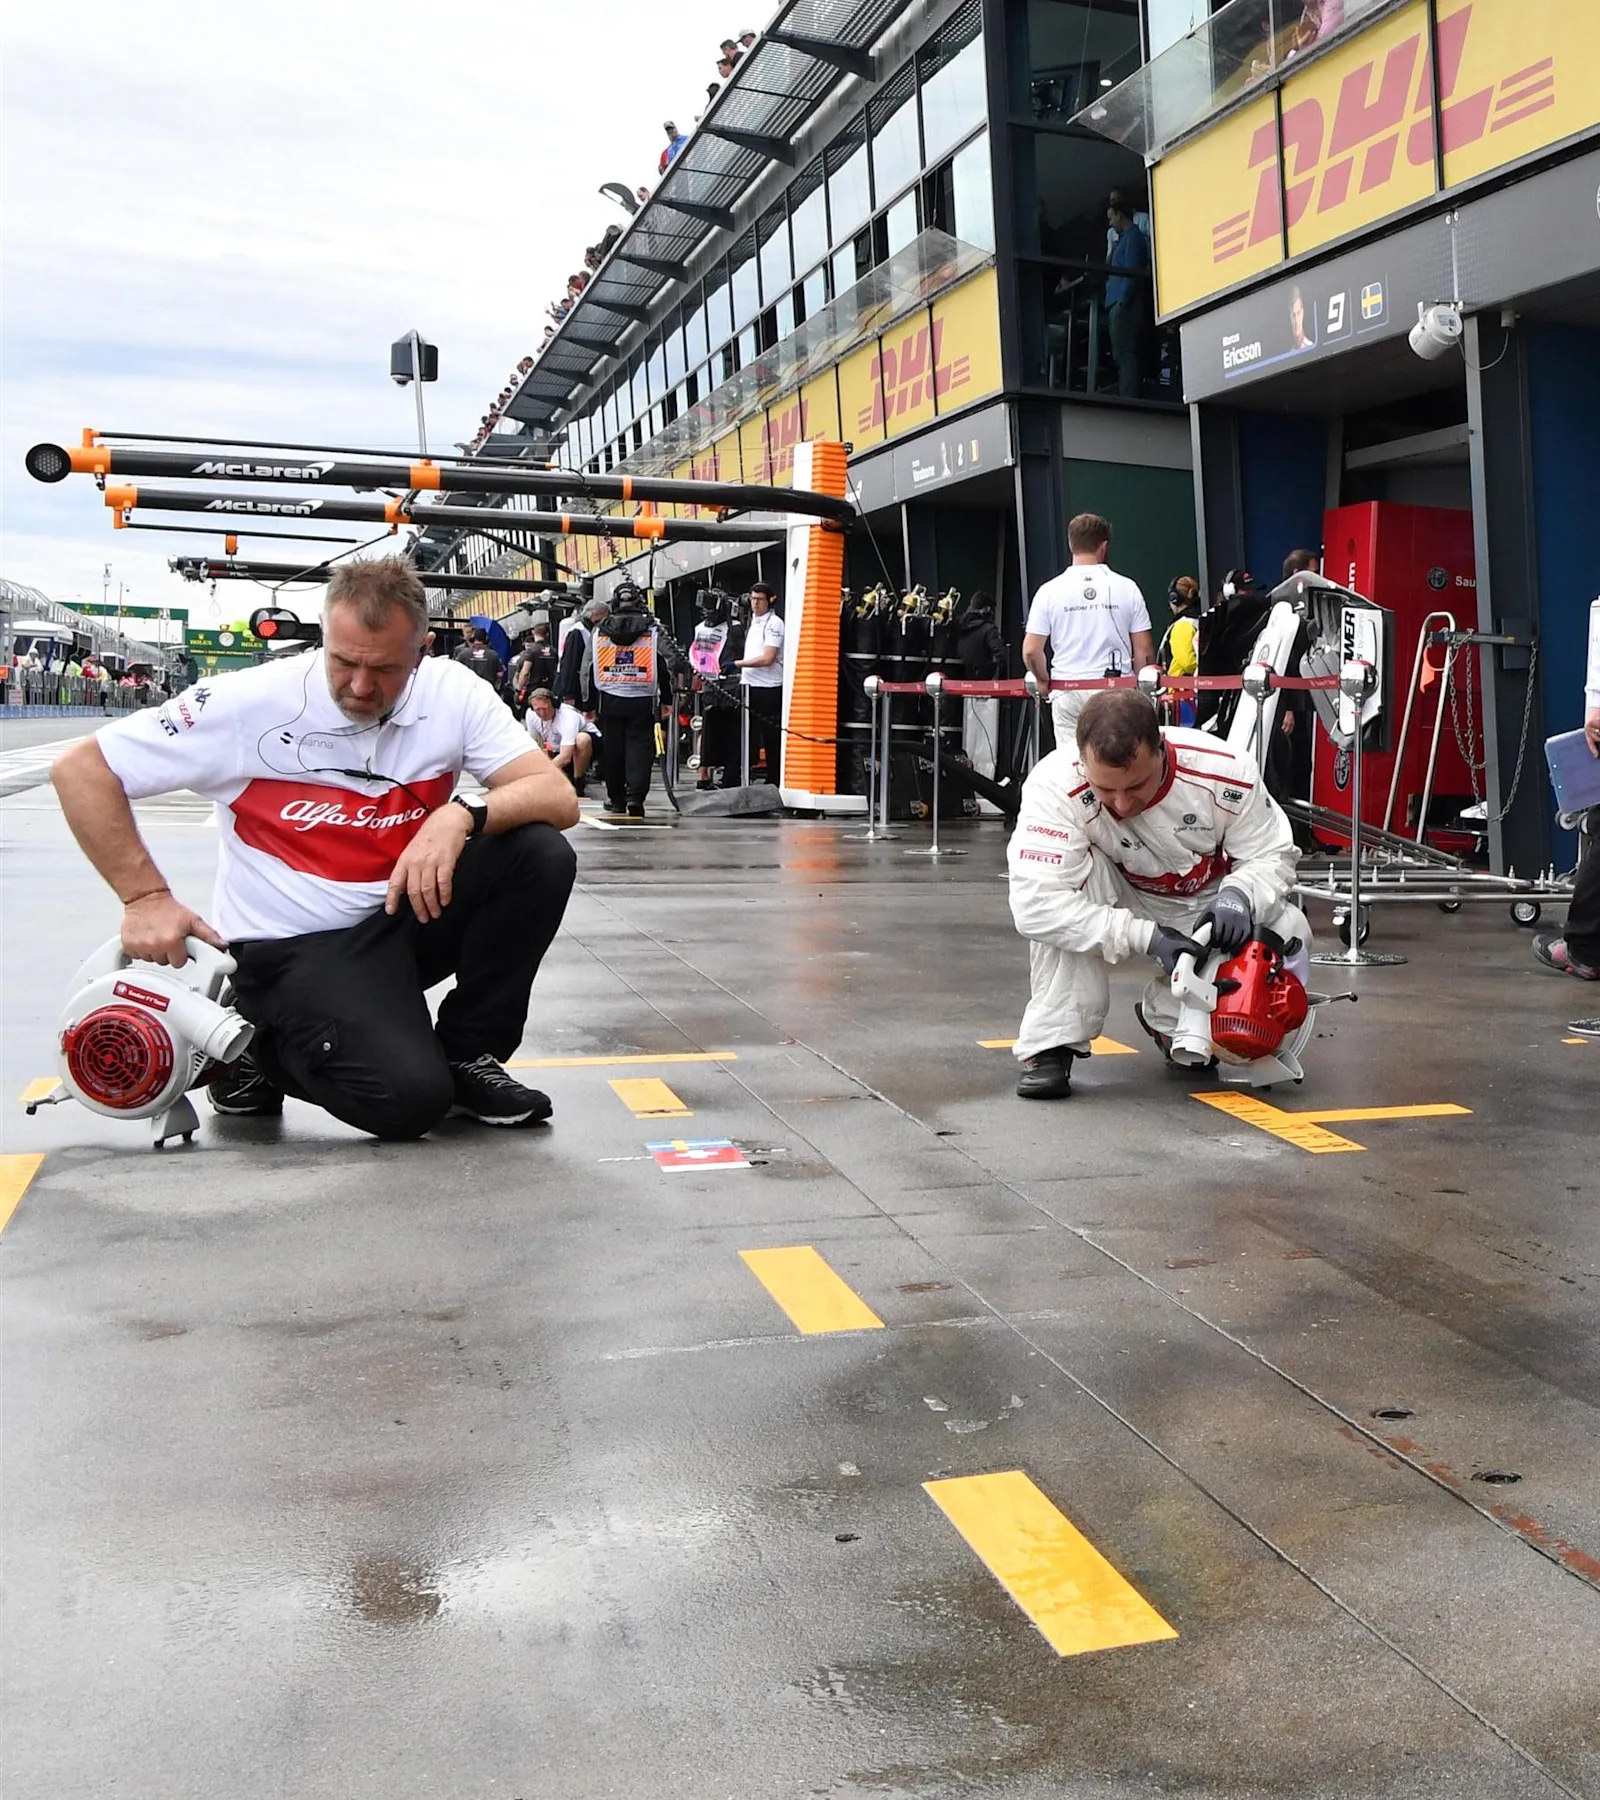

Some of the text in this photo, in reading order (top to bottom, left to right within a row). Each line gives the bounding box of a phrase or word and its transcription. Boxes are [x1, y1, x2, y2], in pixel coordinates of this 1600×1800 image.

[1247, 4, 1496, 249] DHL
[1326, 292, 1346, 334] 9
[1222, 341, 1262, 369] Ericsson
[871, 317, 952, 428] DHL
[191, 461, 320, 479] McLaren
[204, 499, 311, 515] McLaren
[1455, 575, 1476, 588] Sau
[1223, 790, 1244, 801] OMP
[280, 800, 351, 832] Alfa
[1026, 824, 1070, 841] CARRERA
[1019, 849, 1063, 865] PIRELLI
